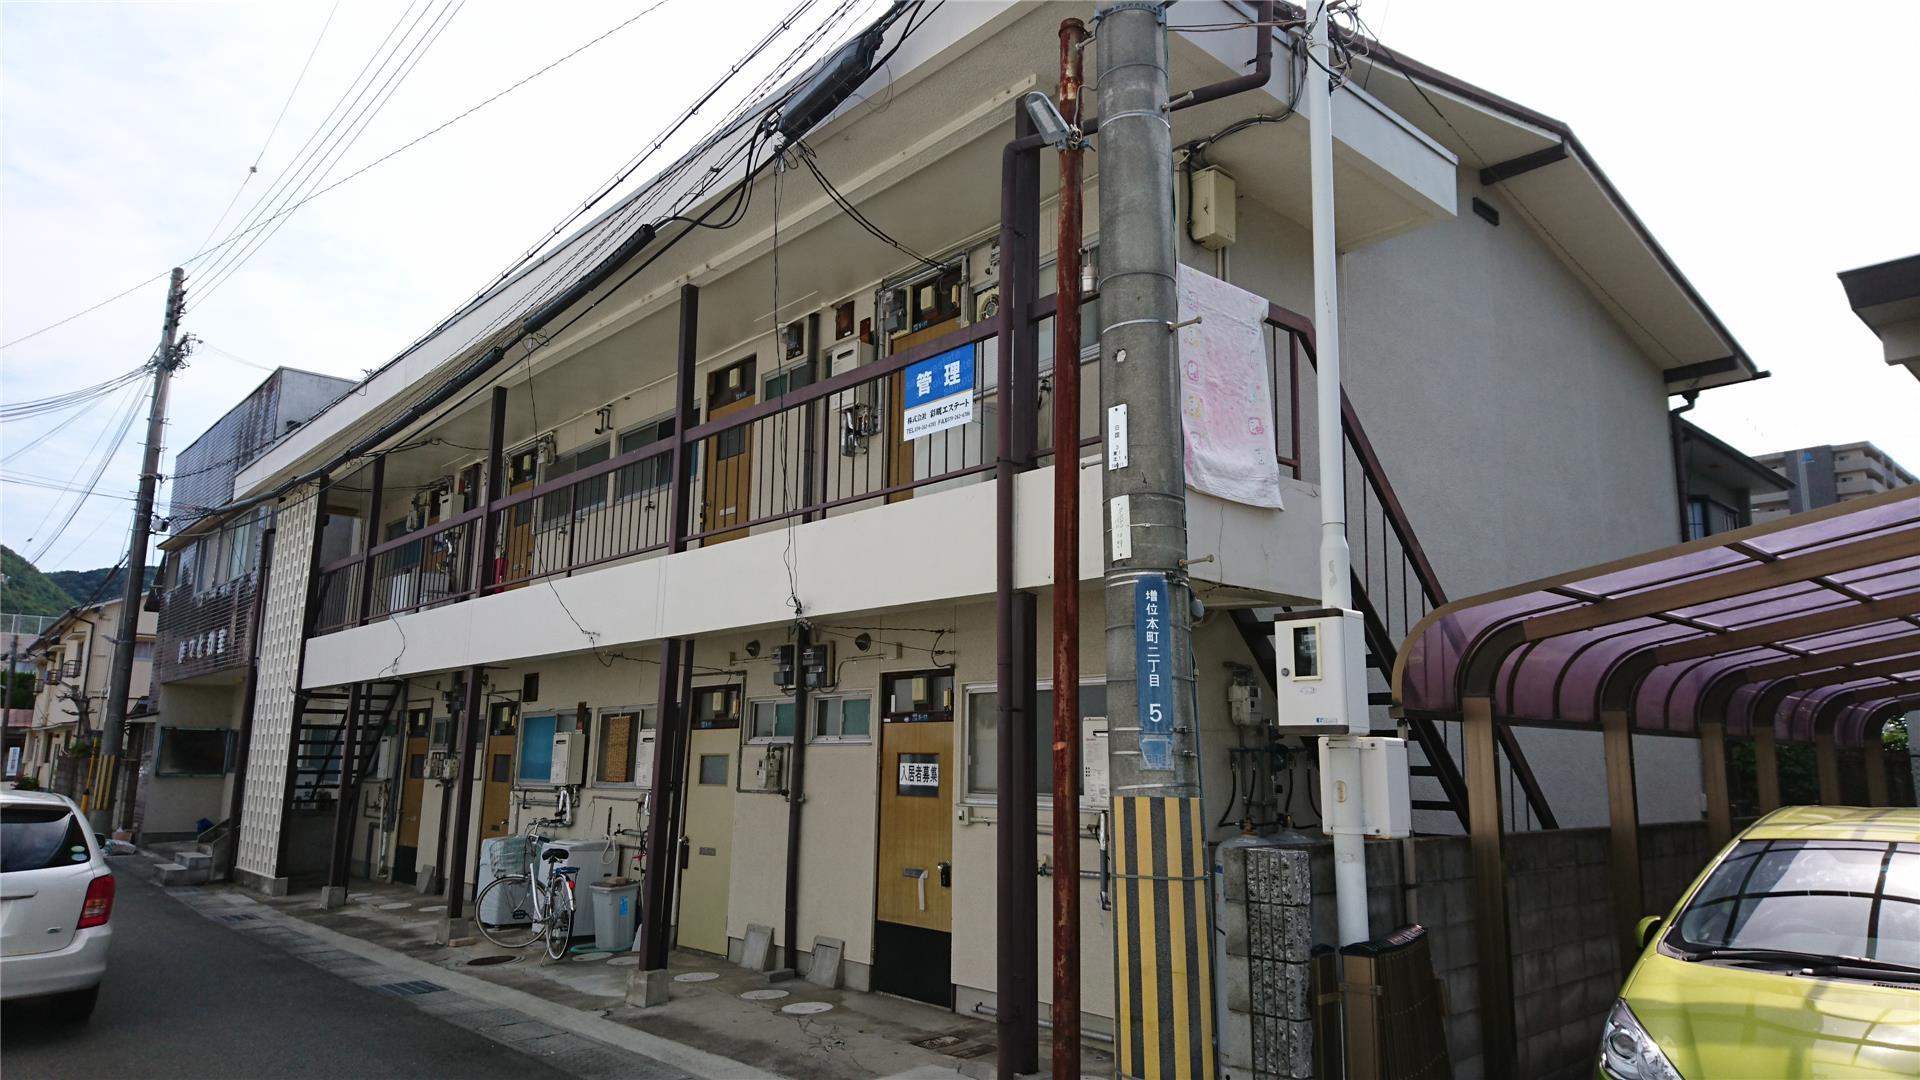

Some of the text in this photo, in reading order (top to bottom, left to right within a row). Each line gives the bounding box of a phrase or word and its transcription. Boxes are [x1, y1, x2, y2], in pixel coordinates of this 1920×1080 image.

[916, 360, 961, 397] 管理
[1145, 589, 1163, 722] 増位本町二丁目 5
[900, 764, 938, 783] 入居者募集
